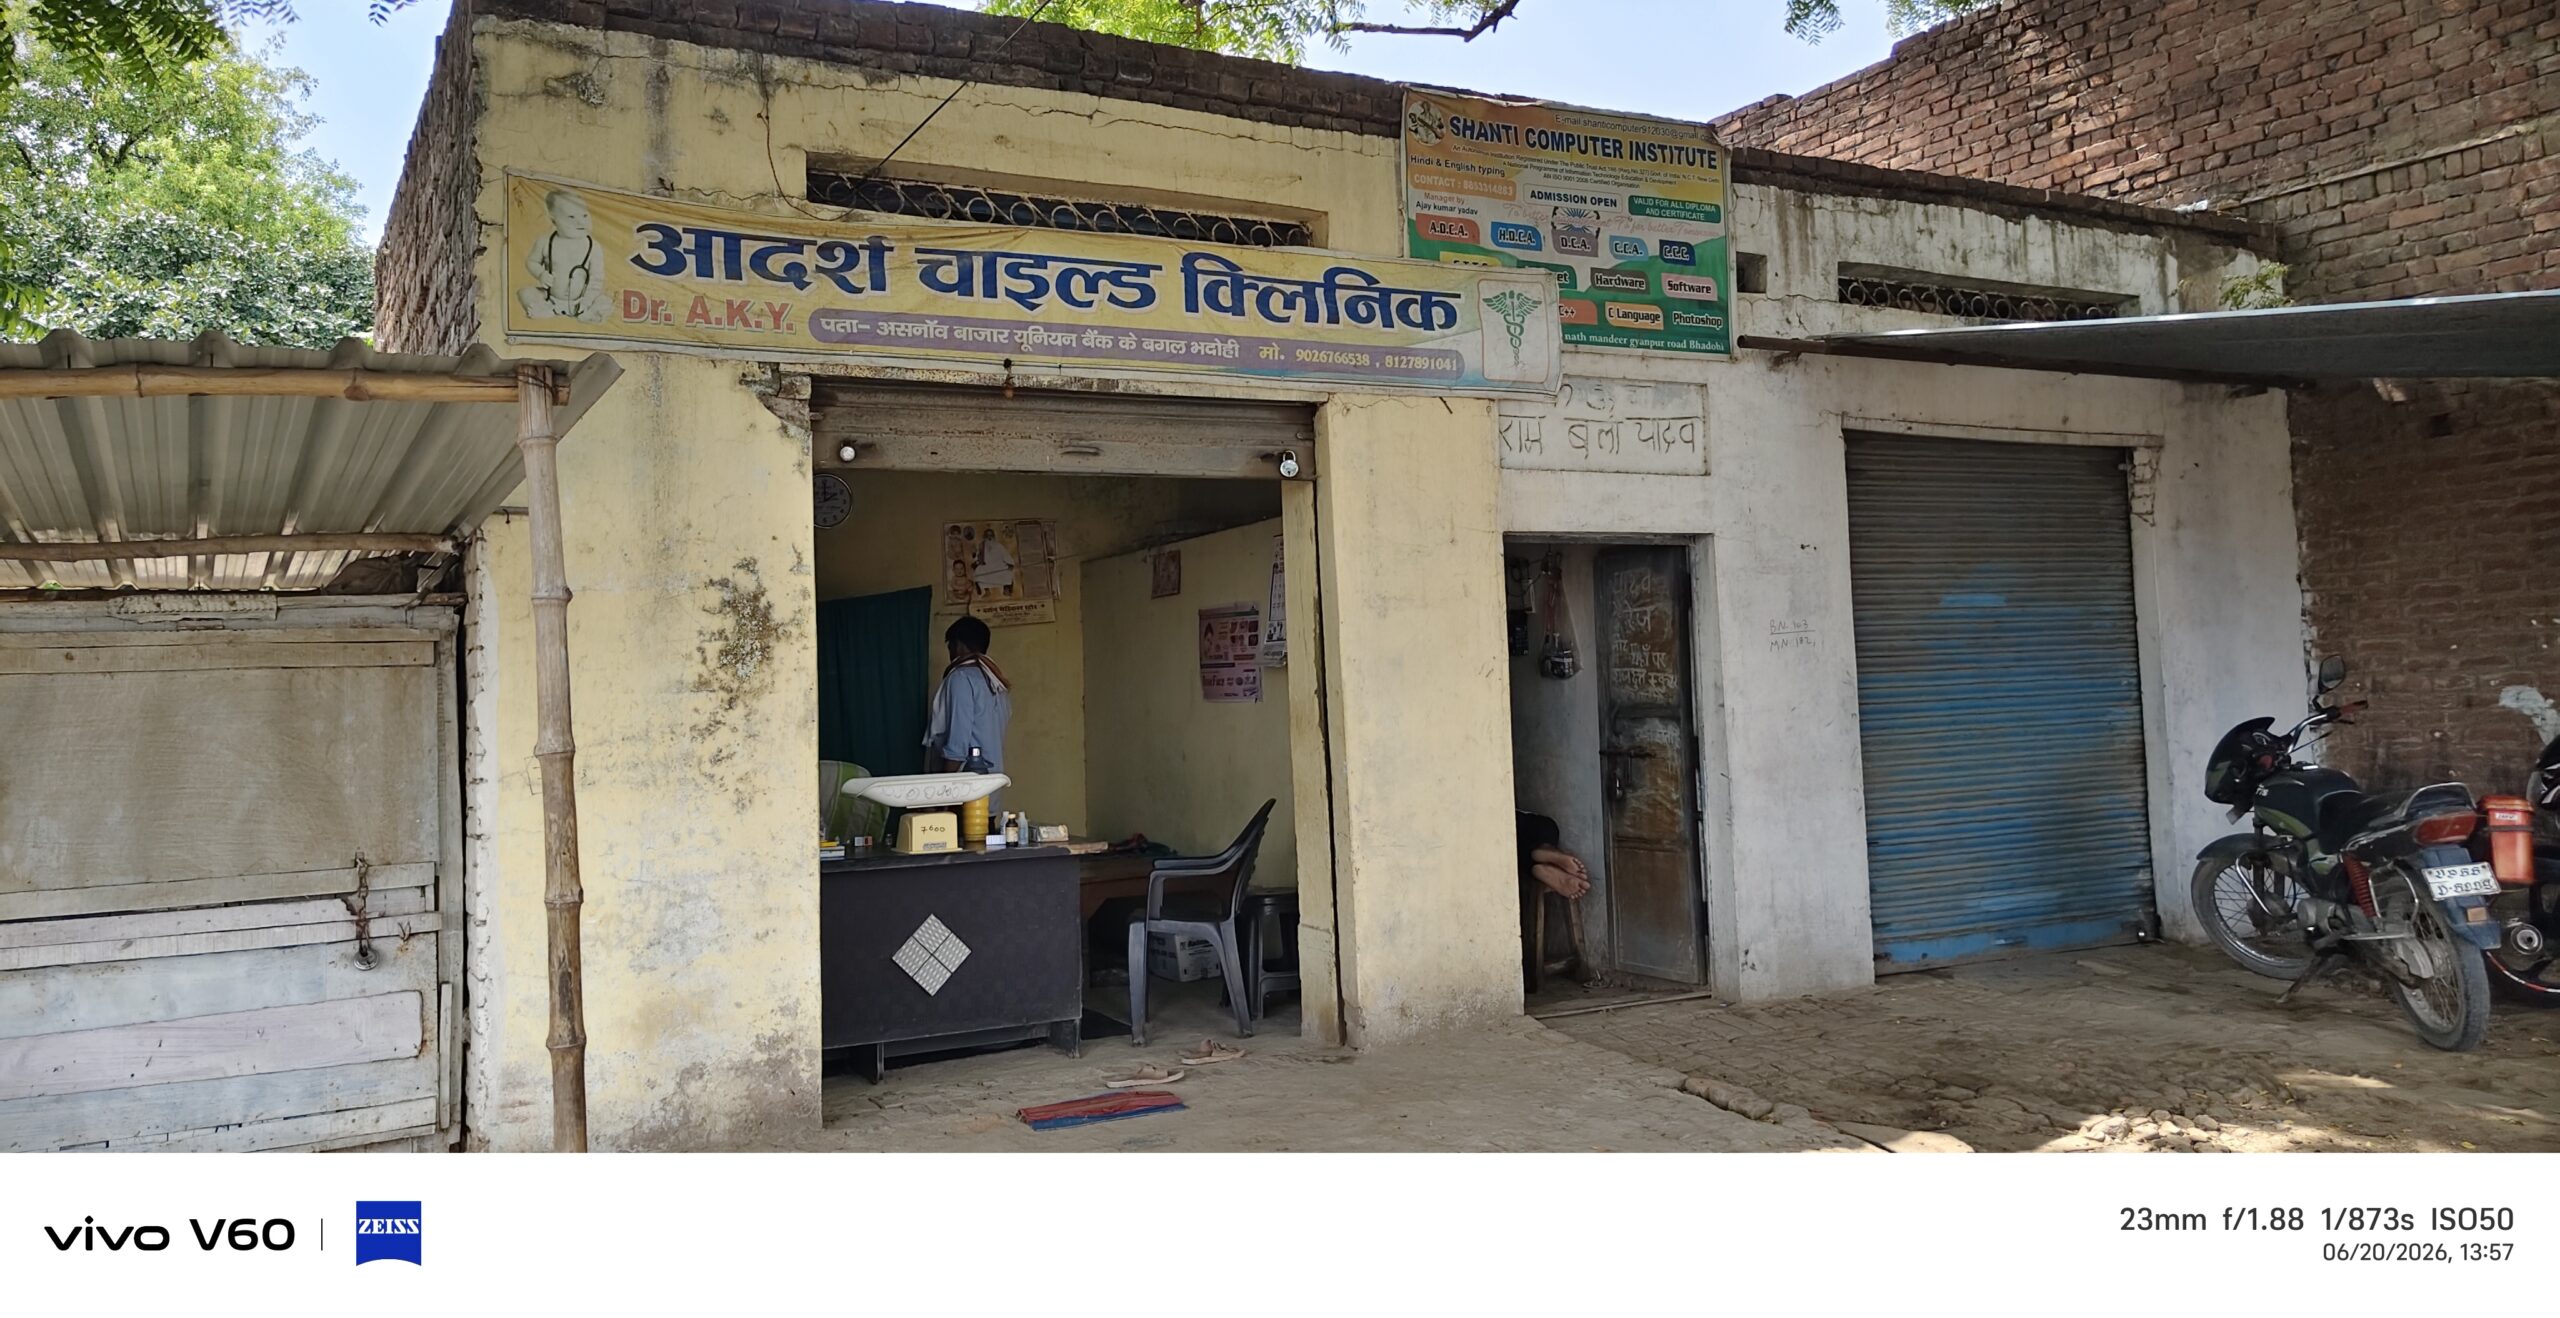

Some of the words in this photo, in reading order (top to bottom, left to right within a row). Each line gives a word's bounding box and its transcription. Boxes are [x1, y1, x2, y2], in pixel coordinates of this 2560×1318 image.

[1449, 115, 1519, 146] SHANTI
[1525, 127, 1624, 160] COMPUTER
[1628, 140, 1718, 170] INSTITUTE
[1410, 155, 1433, 165] Hindi
[1436, 159, 1441, 167] &
[1444, 160, 1475, 173] English
[1478, 166, 1505, 177] typing
[1414, 174, 1456, 188] CONTACT
[1530, 190, 1587, 205] ADMISSION
[1590, 196, 1617, 208] OPEN
[1634, 197, 1655, 207] VALID
[1656, 199, 1669, 208] FOR
[1670, 201, 1683, 210] ALL
[1685, 202, 1716, 213] DIPLOMA
[1416, 200, 1431, 211] Ajay
[1433, 203, 1456, 212] kumar
[1458, 206, 1478, 215] yadav
[1646, 207, 1660, 216] AND
[1661, 209, 1705, 221] CERTIFICATE
[1429, 221, 1468, 237] A.D.C.A.
[1499, 227, 1536, 244] H.D.C.A.
[1561, 236, 1591, 251] D.C.A.
[1614, 241, 1643, 256] C.C.A.
[1663, 246, 1690, 260] C.C.C.
[629, 221, 894, 295] आदर्श
[914, 246, 1164, 312] चाइल्ड
[1180, 251, 1462, 332] क्लिनिक
[1596, 275, 1645, 289] Hardware
[1667, 280, 1712, 294] Software
[623, 288, 673, 325] Dr.
[686, 296, 796, 332] A.K.Y.
[1608, 308, 1614, 318] C
[1616, 308, 1661, 324] Language
[1673, 312, 1723, 329] Photoshop
[953, 325, 1010, 343] बाजार
[1013, 325, 1077, 352] यूनियन
[1081, 329, 1114, 349] बैंक
[1118, 332, 1137, 350] के
[1142, 338, 1187, 354] बगल
[1191, 338, 1240, 359] भदोही
[1258, 342, 1285, 361] मो.
[1296, 348, 1370, 366] 9026766538
[1385, 354, 1458, 371] 8127891041
[1564, 332, 1587, 342] nath
[1589, 335, 1627, 345] mandeer
[1629, 338, 1665, 349] gyanpur
[1667, 339, 1687, 349] road
[1689, 340, 1725, 351] Bhadohi
[1625, 416, 1701, 454] यादव
